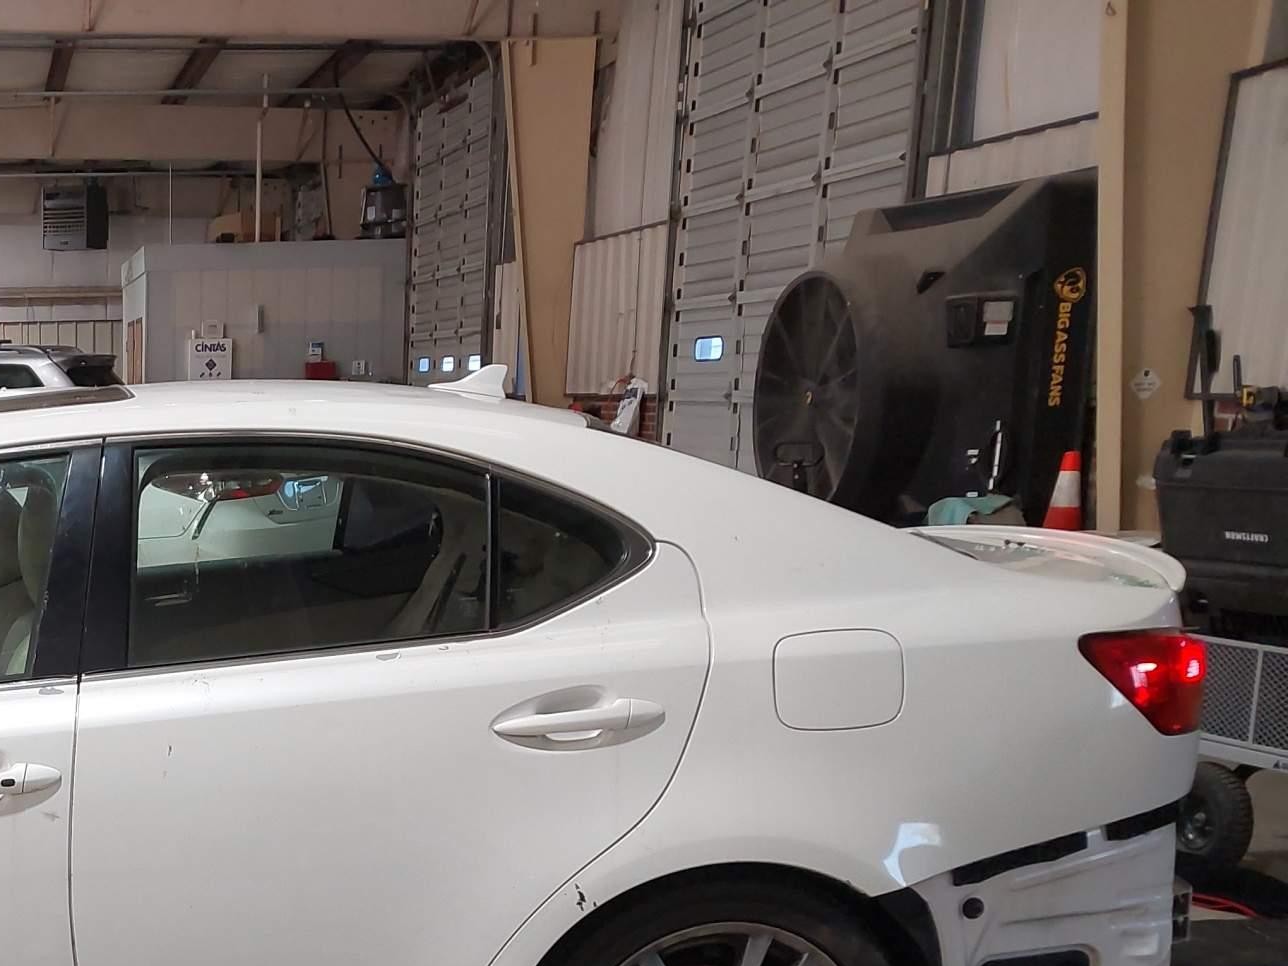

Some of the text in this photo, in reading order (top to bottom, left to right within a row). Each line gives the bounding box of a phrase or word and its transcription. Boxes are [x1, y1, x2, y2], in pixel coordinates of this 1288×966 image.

[195, 341, 227, 352] CINTAS
[1047, 302, 1072, 407] BIG ASS FANS
